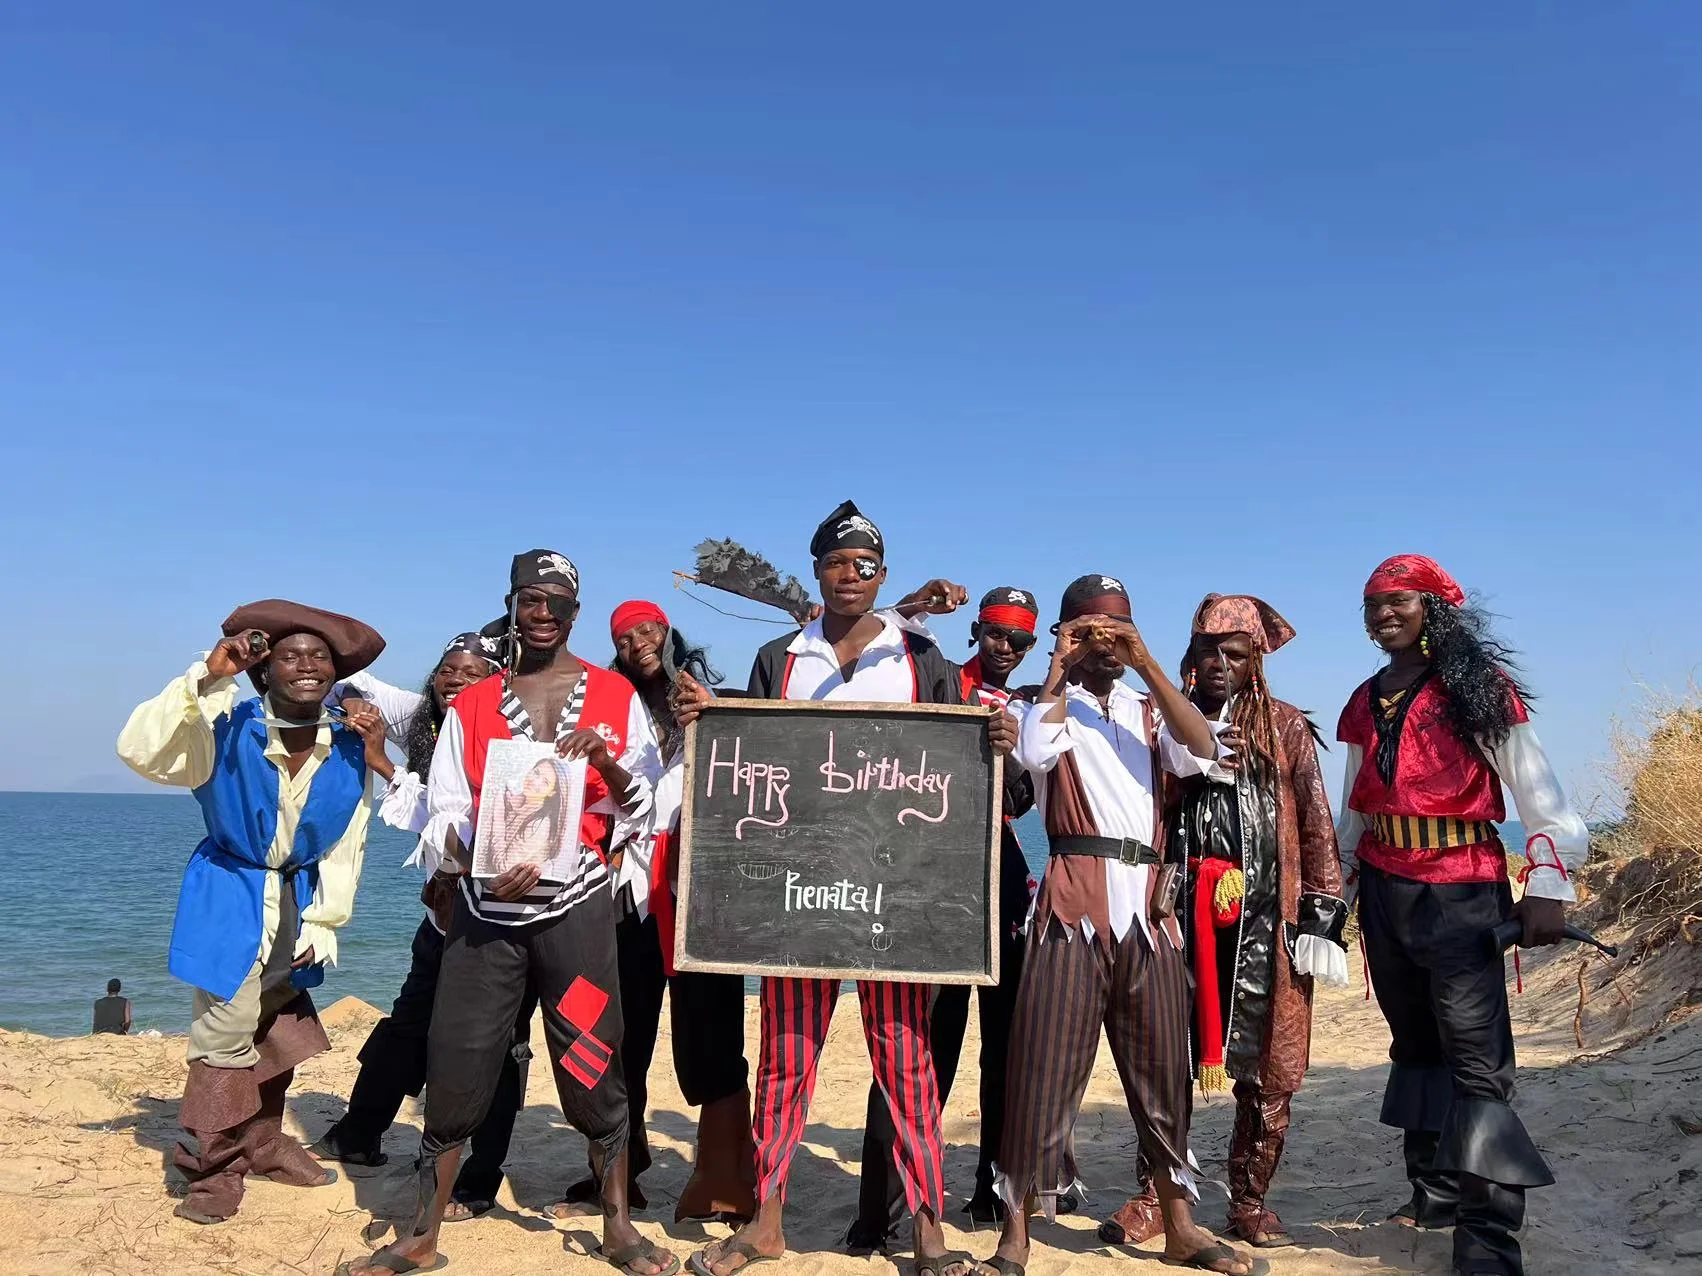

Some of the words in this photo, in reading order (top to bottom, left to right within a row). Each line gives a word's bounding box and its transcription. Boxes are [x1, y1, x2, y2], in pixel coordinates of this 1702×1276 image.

[707, 736, 790, 840] Happy
[819, 730, 952, 826] birthday
[784, 868, 884, 934] Renata!
